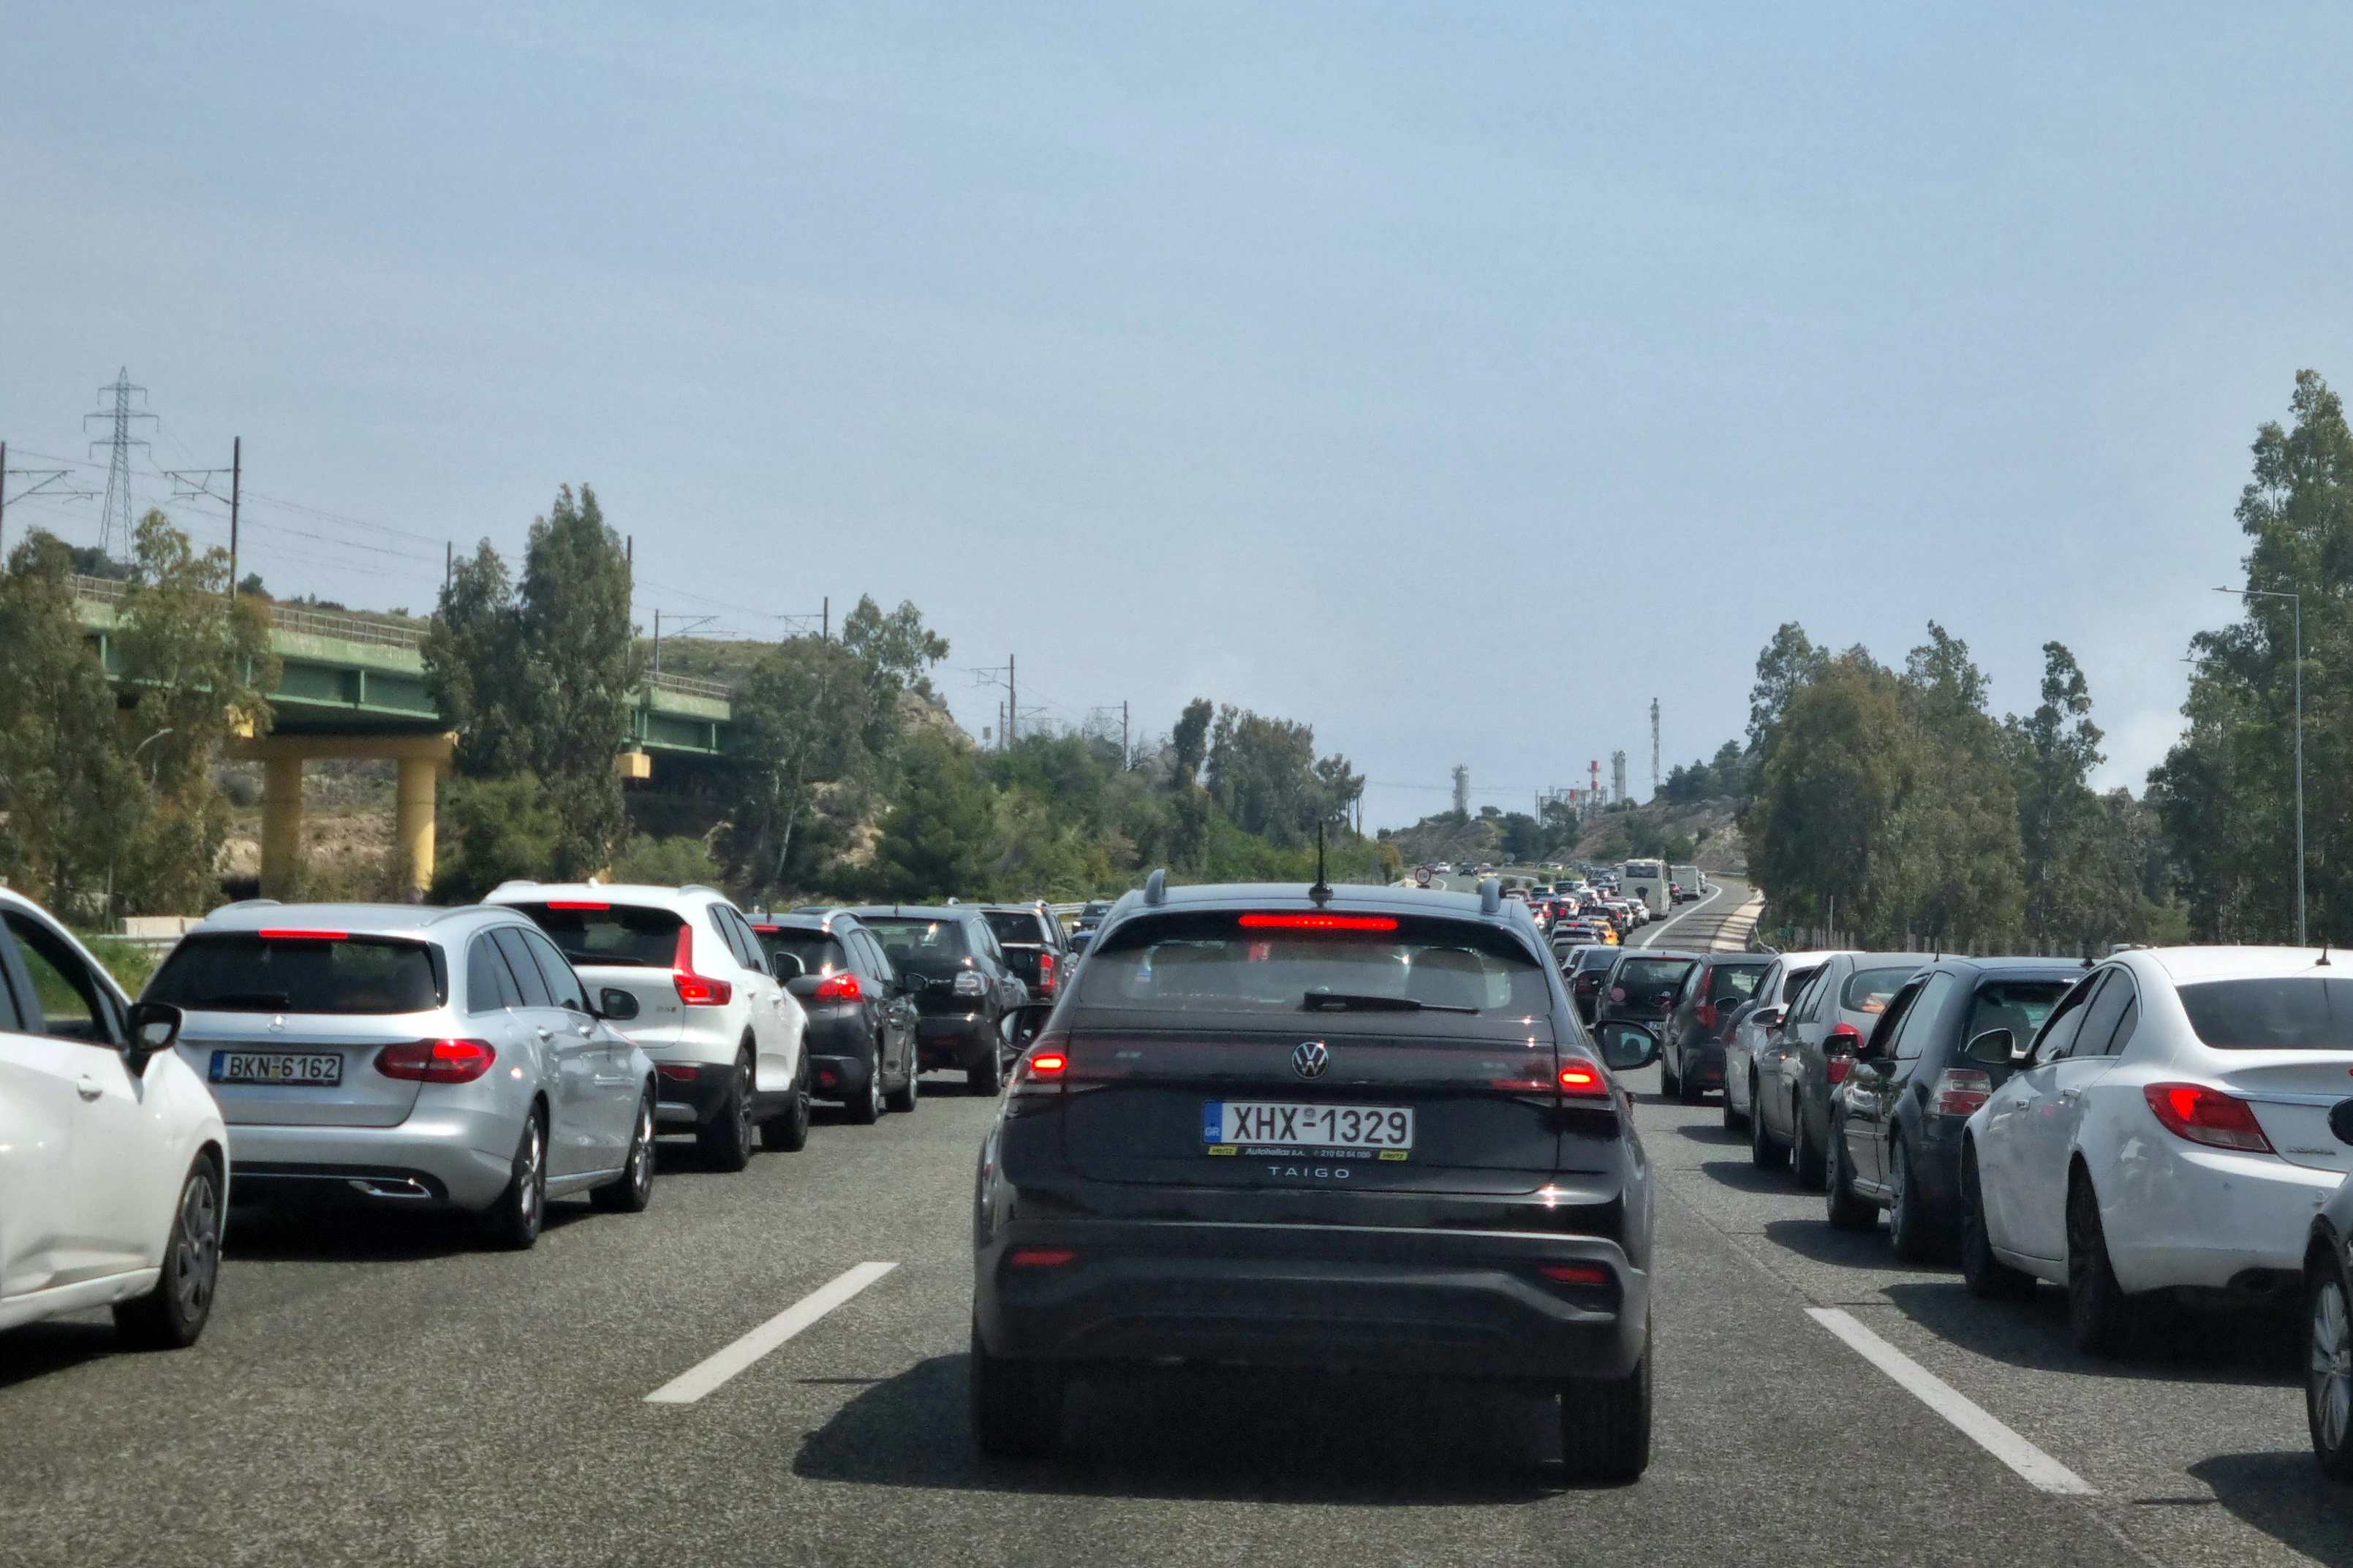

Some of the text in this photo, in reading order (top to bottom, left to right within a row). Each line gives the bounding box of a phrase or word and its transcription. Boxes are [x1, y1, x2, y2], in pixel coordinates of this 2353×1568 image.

[1205, 1126, 1220, 1137] GR
[1234, 1107, 1407, 1144] XHX-1329
[1267, 1166, 1349, 1178] TAIGO
